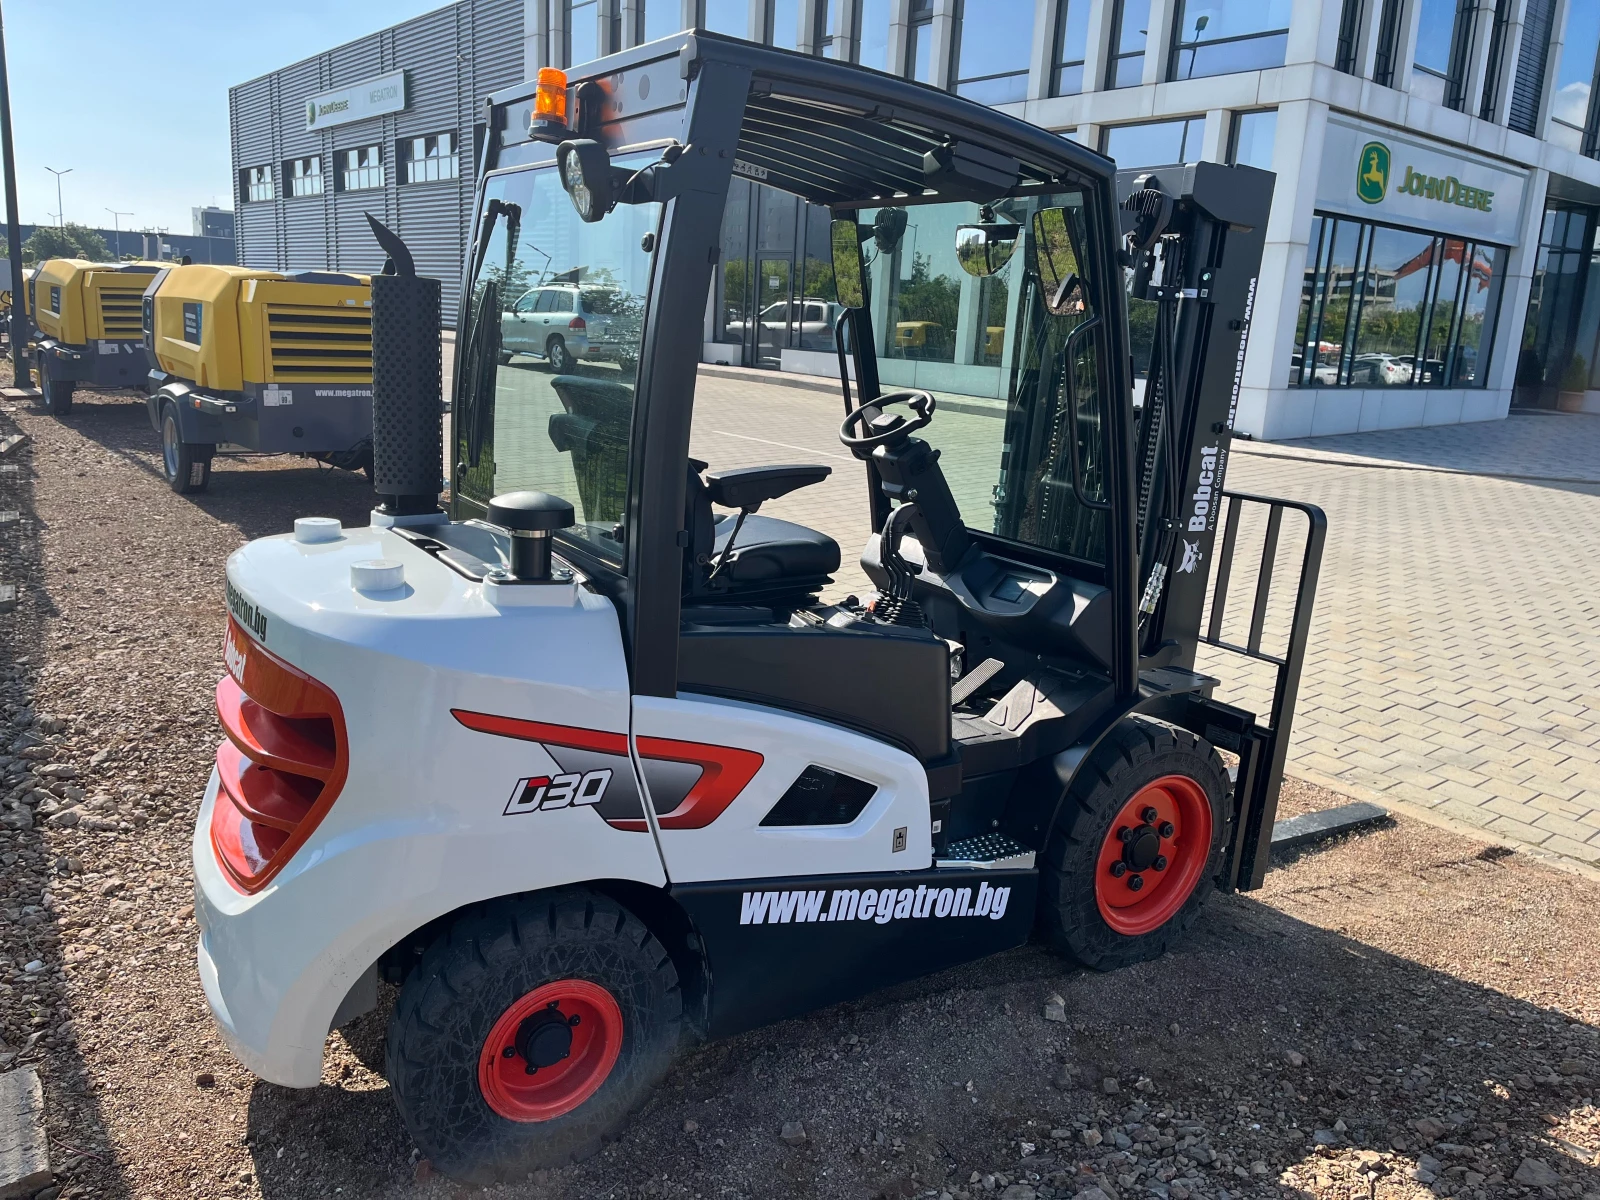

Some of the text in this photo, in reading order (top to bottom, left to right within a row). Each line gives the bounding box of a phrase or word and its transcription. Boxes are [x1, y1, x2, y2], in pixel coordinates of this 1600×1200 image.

[369, 85, 398, 104] MEGATRON
[1187, 446, 1219, 531] Bobcat
[1209, 490, 1219, 522] Doosan
[1214, 448, 1227, 488] Company
[502, 768, 614, 816] D30
[739, 881, 1011, 925] www.megatron.bg
